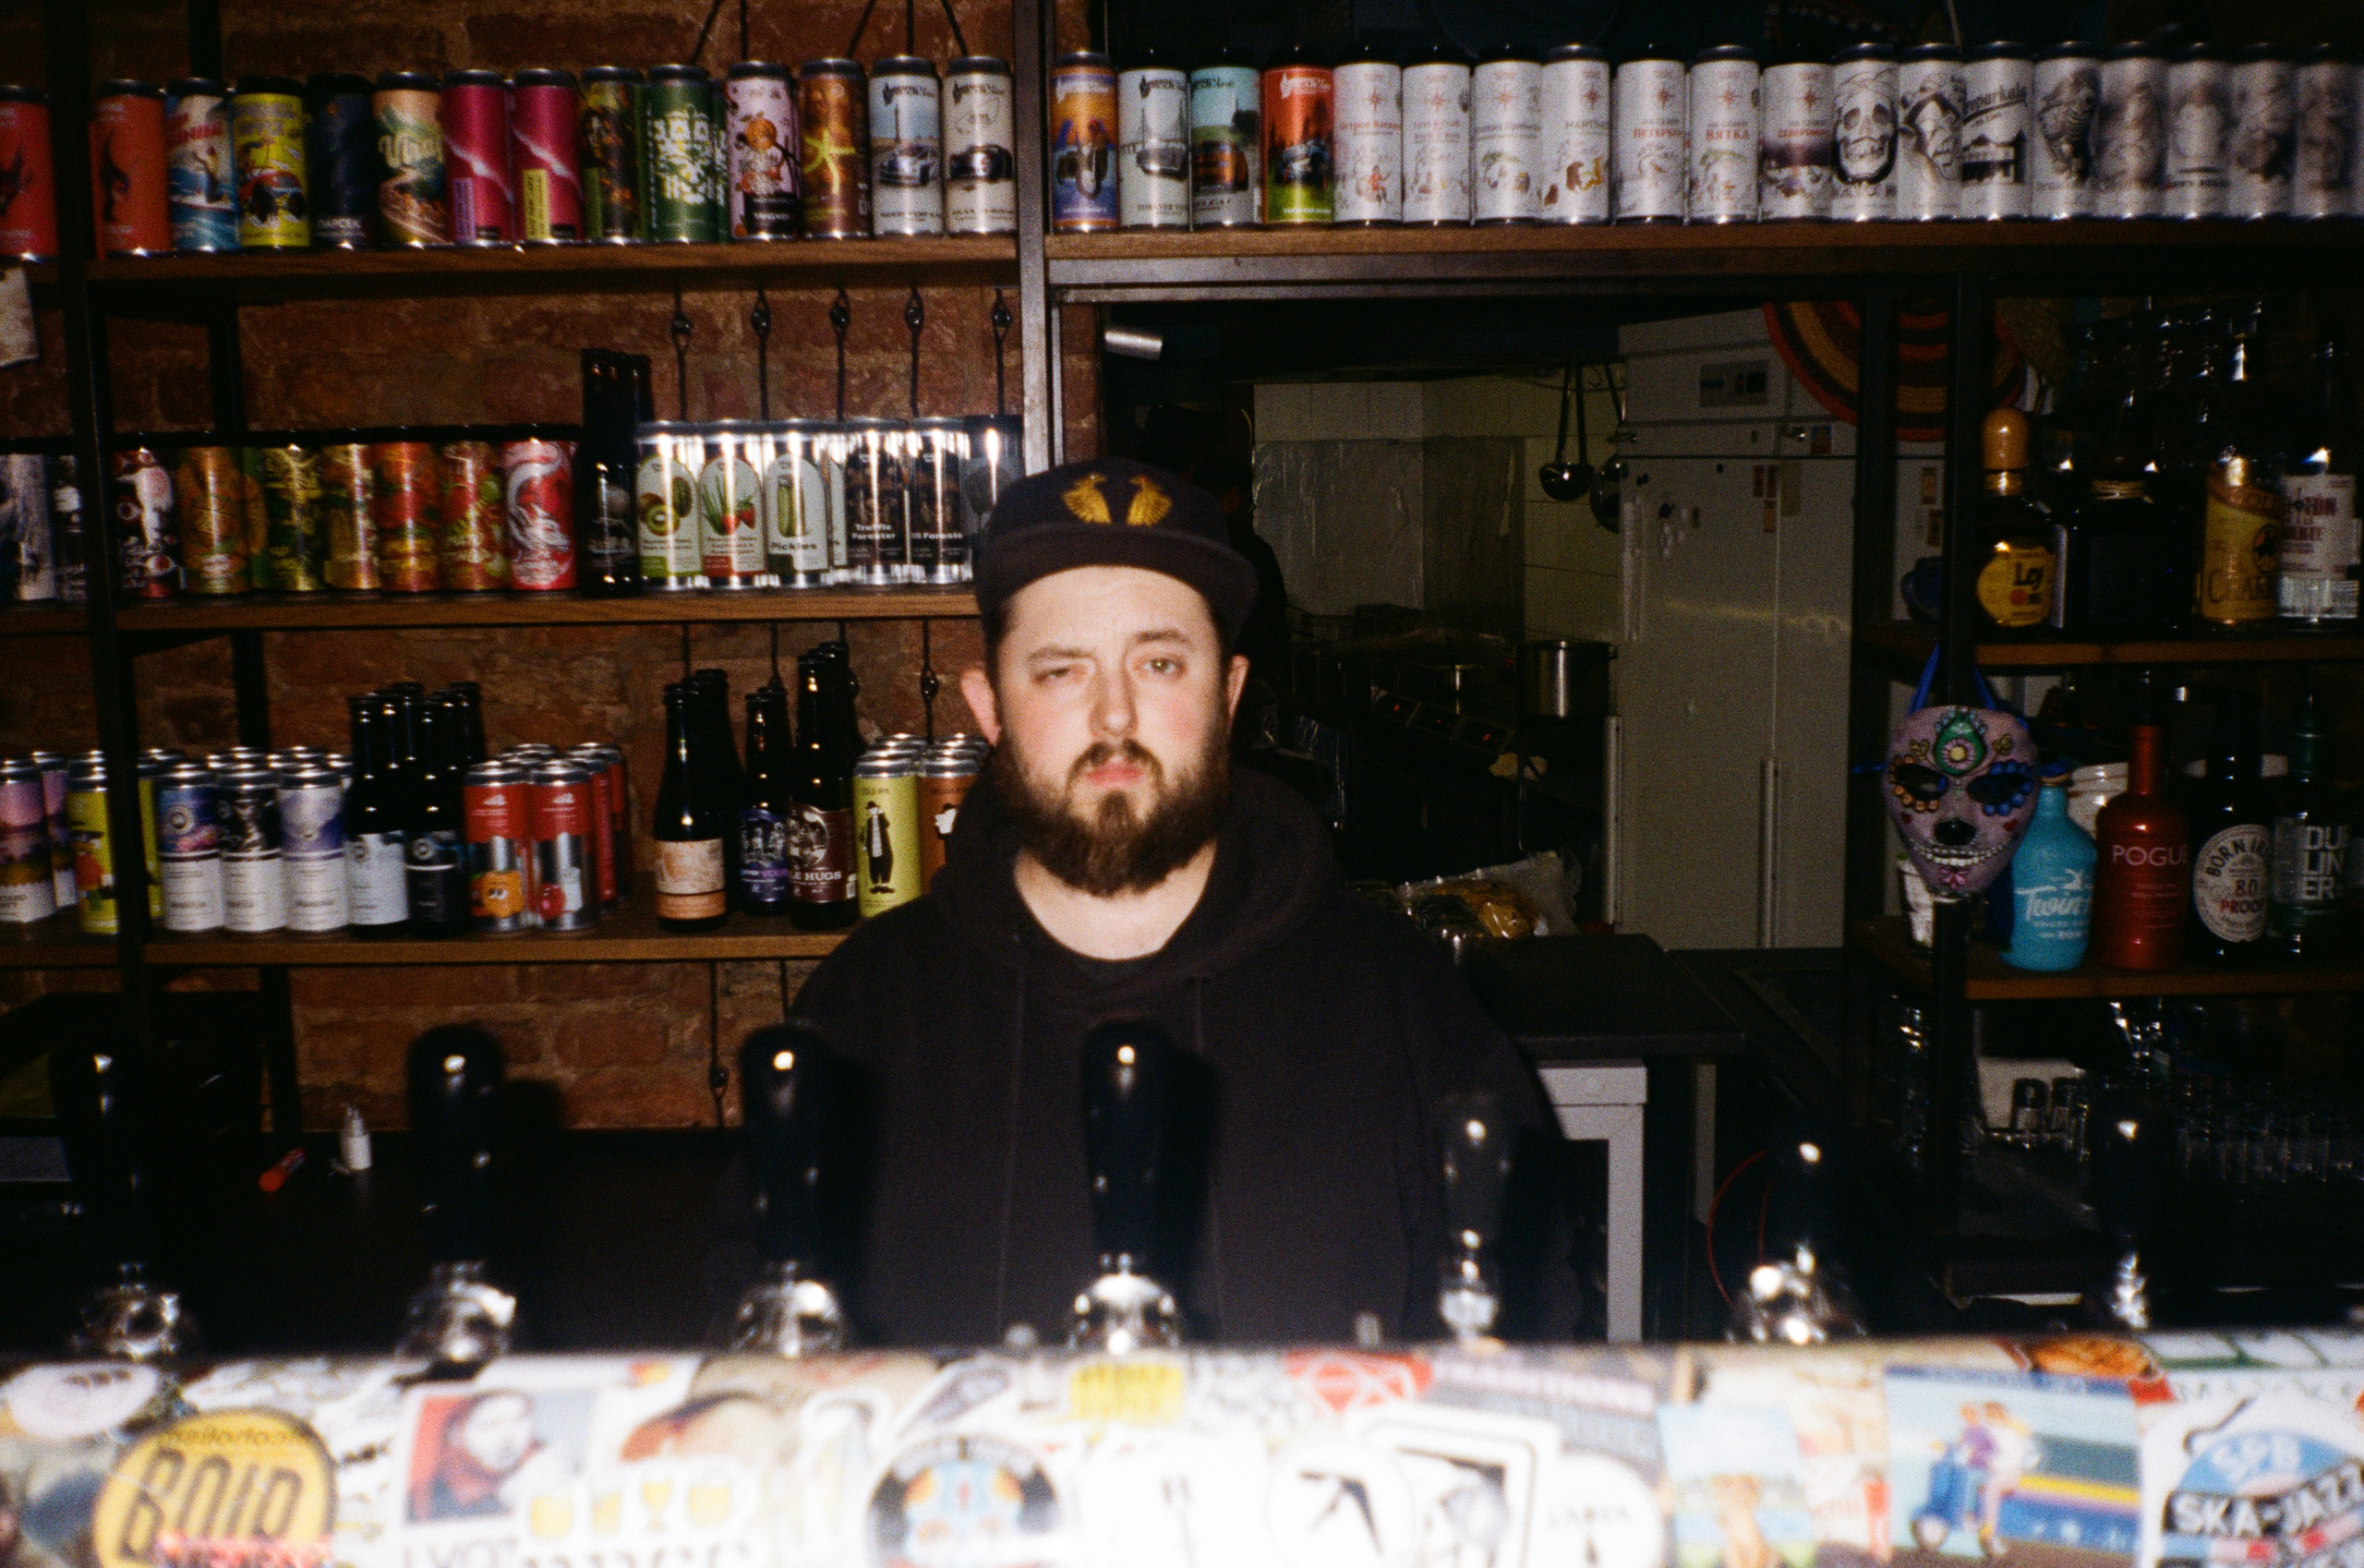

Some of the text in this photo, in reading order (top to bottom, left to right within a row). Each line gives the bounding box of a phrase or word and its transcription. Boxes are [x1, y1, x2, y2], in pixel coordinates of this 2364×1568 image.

[1705, 128, 1750, 141] ВЯТКА
[851, 532, 897, 540] Forester
[770, 542, 818, 551] Pickles
[2205, 838, 2247, 877] BORN
[804, 871, 842, 881] HUGS
[2173, 1458, 2364, 1537] SKA-JAZZ
